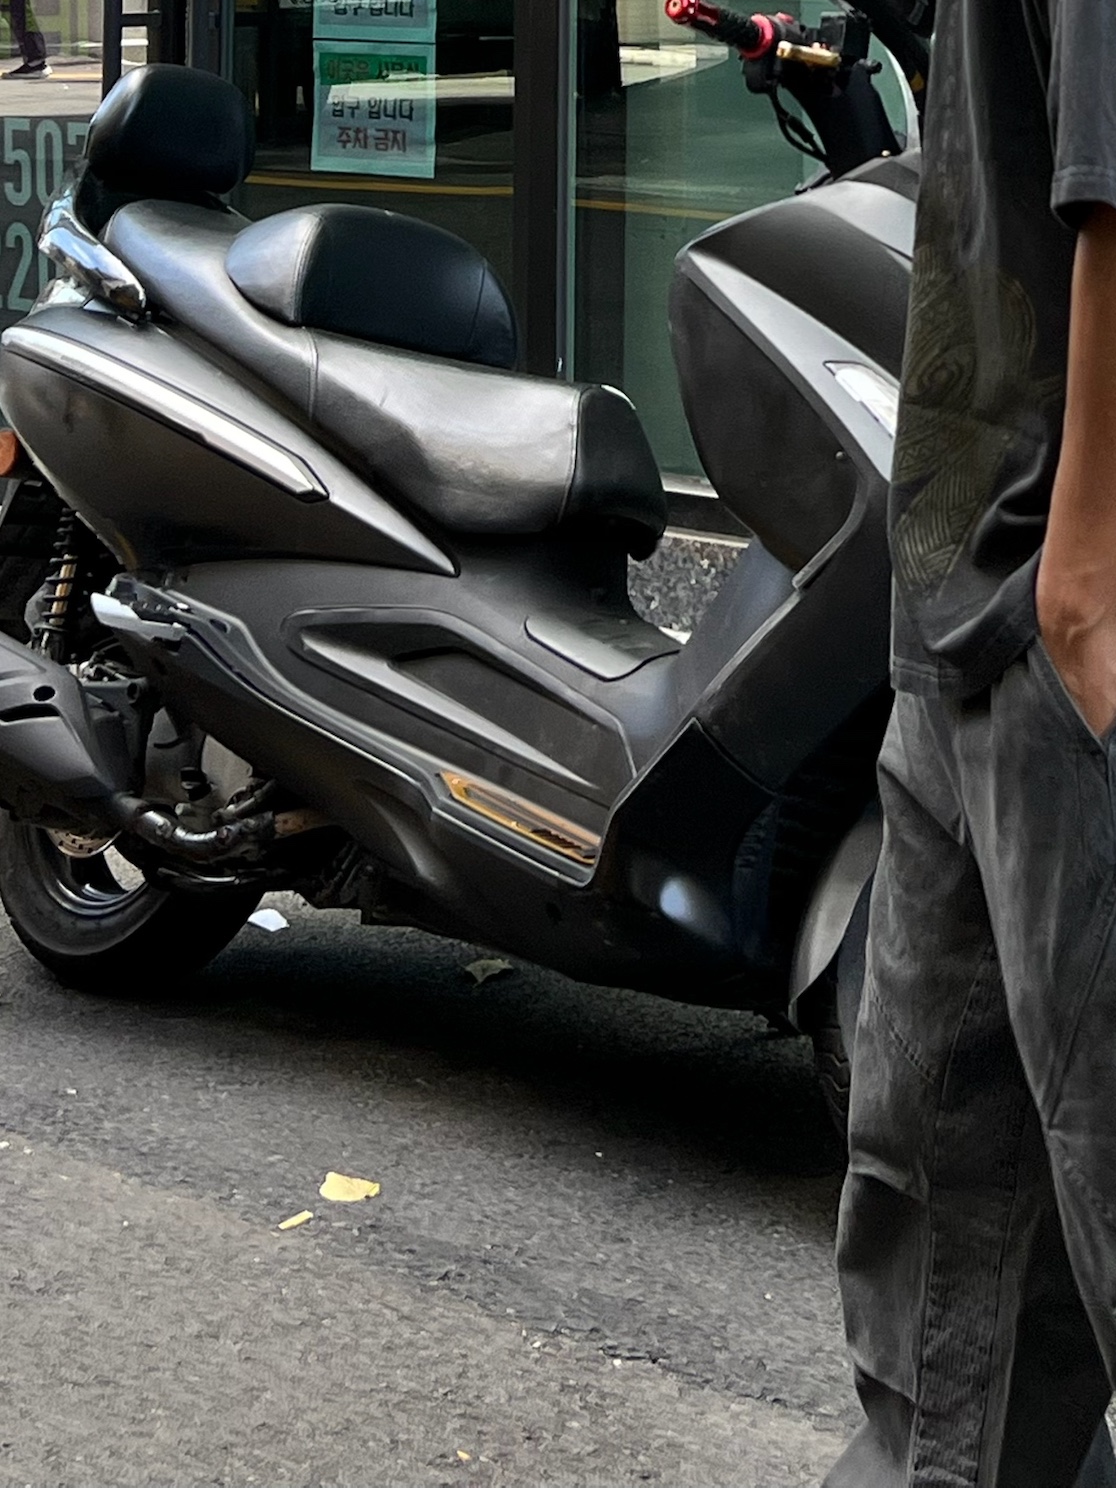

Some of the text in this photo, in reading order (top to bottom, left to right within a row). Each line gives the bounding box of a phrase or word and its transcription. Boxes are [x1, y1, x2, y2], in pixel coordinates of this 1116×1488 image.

[331, 94, 414, 122] 입구 입니다
[336, 125, 407, 153] 주차 금지
